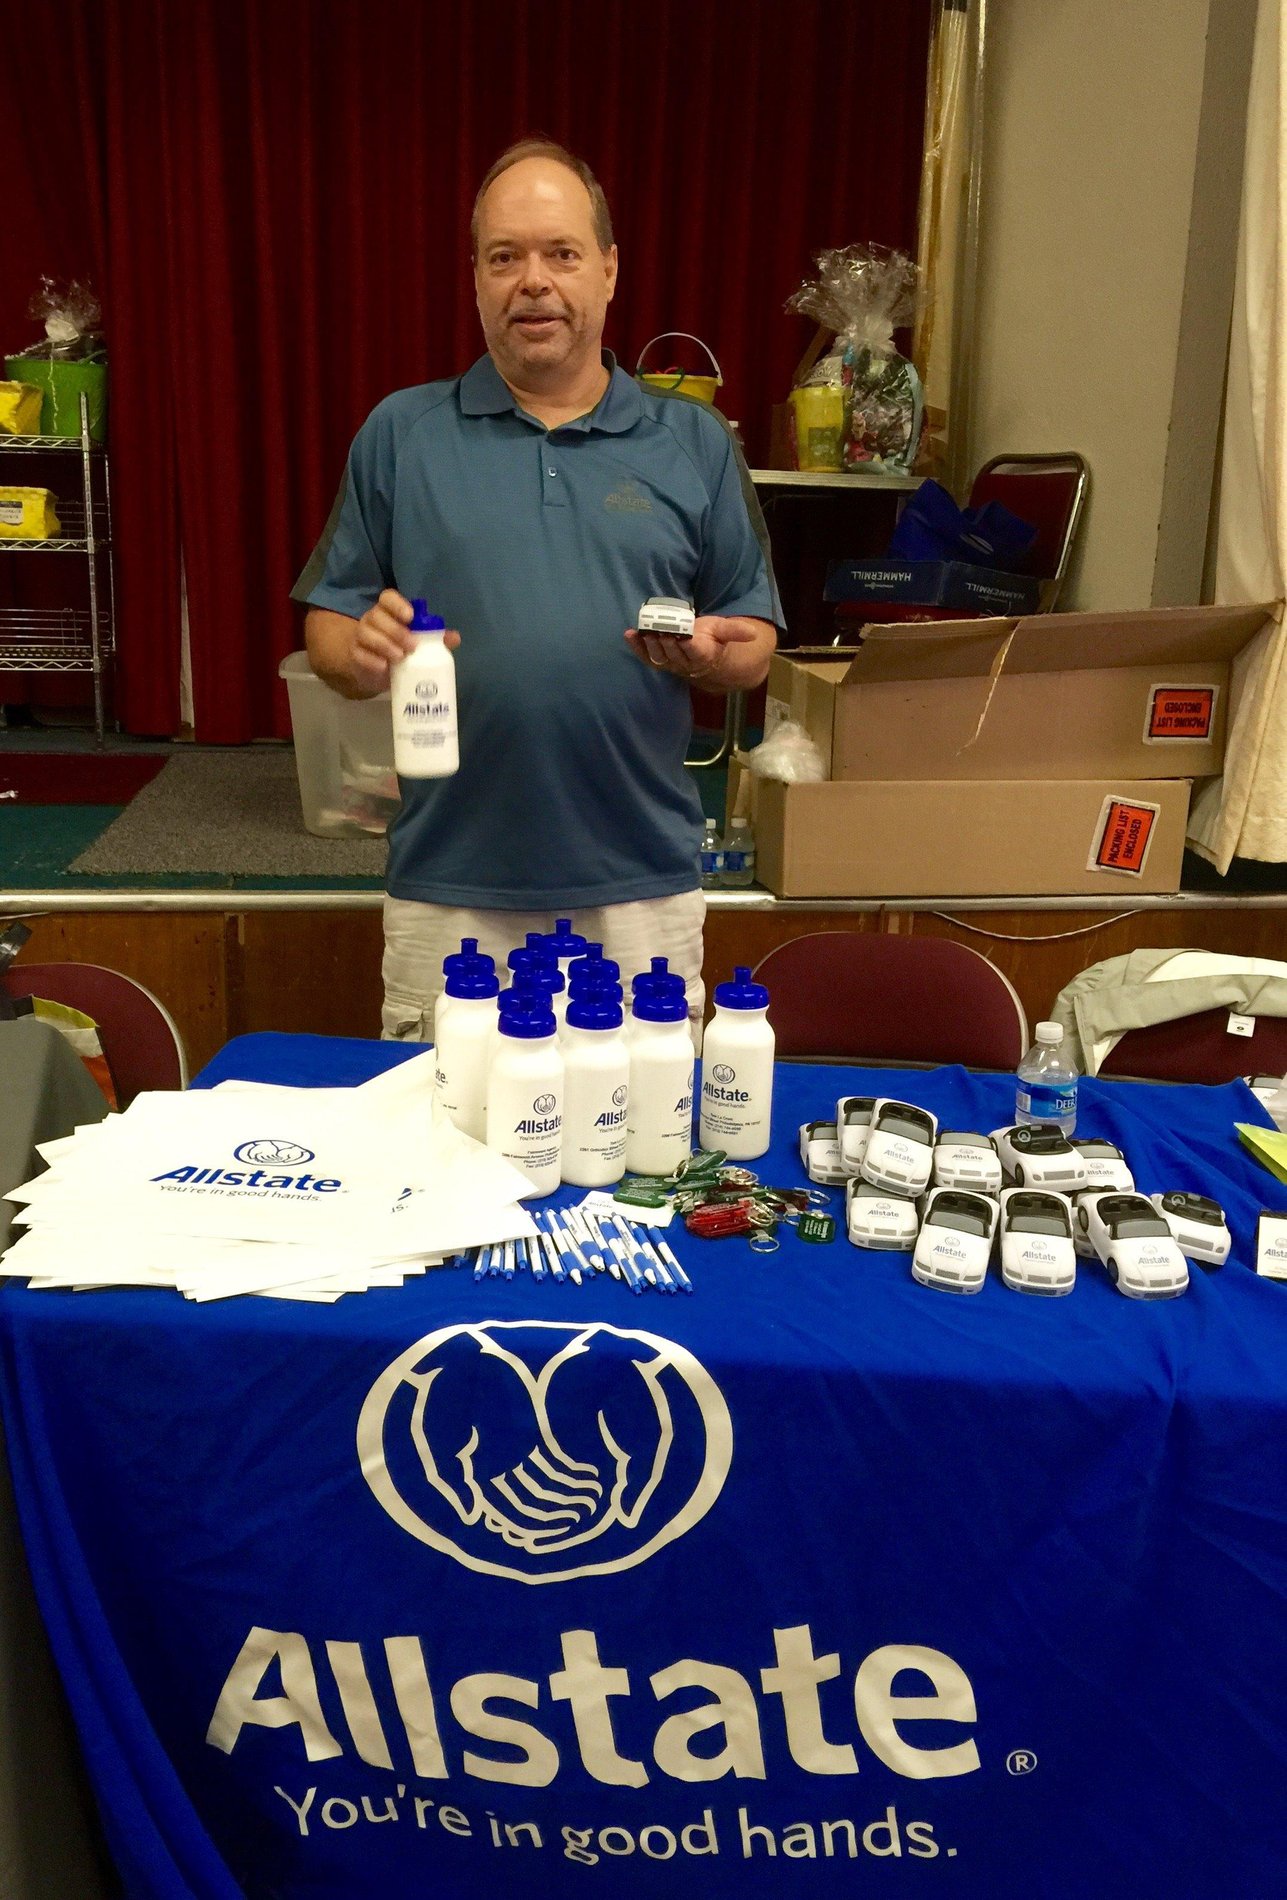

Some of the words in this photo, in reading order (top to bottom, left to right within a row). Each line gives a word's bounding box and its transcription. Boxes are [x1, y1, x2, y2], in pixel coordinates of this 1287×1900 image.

[851, 571, 911, 582] HAMMERMILL
[965, 582, 1025, 600] HAMMERMILL
[1164, 702, 1203, 714] ENCLOSED
[1156, 717, 1173, 728] LIST
[1174, 717, 1206, 728] PACKING
[1107, 828, 1126, 863] PACKING
[1117, 809, 1130, 827] LIST
[1122, 818, 1142, 859] ENCLOSED
[702, 1081, 749, 1102] Allstate
[882, 1149, 915, 1164] Allstate
[951, 1153, 984, 1161] Allstate
[148, 1165, 342, 1193] Allstate
[159, 1185, 206, 1195] You're
[209, 1187, 225, 1196] in
[226, 1189, 269, 1198] good
[272, 1190, 323, 1202] hands.
[867, 1209, 900, 1218] Allstate
[932, 1245, 967, 1260] Allstate
[1021, 1250, 1057, 1262] Allstate
[1137, 1256, 1171, 1265] Allstate
[205, 1623, 981, 1790] Allstate
[273, 1783, 473, 1837] You're
[485, 1810, 543, 1848] in
[561, 1808, 720, 1866] good
[738, 1806, 958, 1859] hands.
